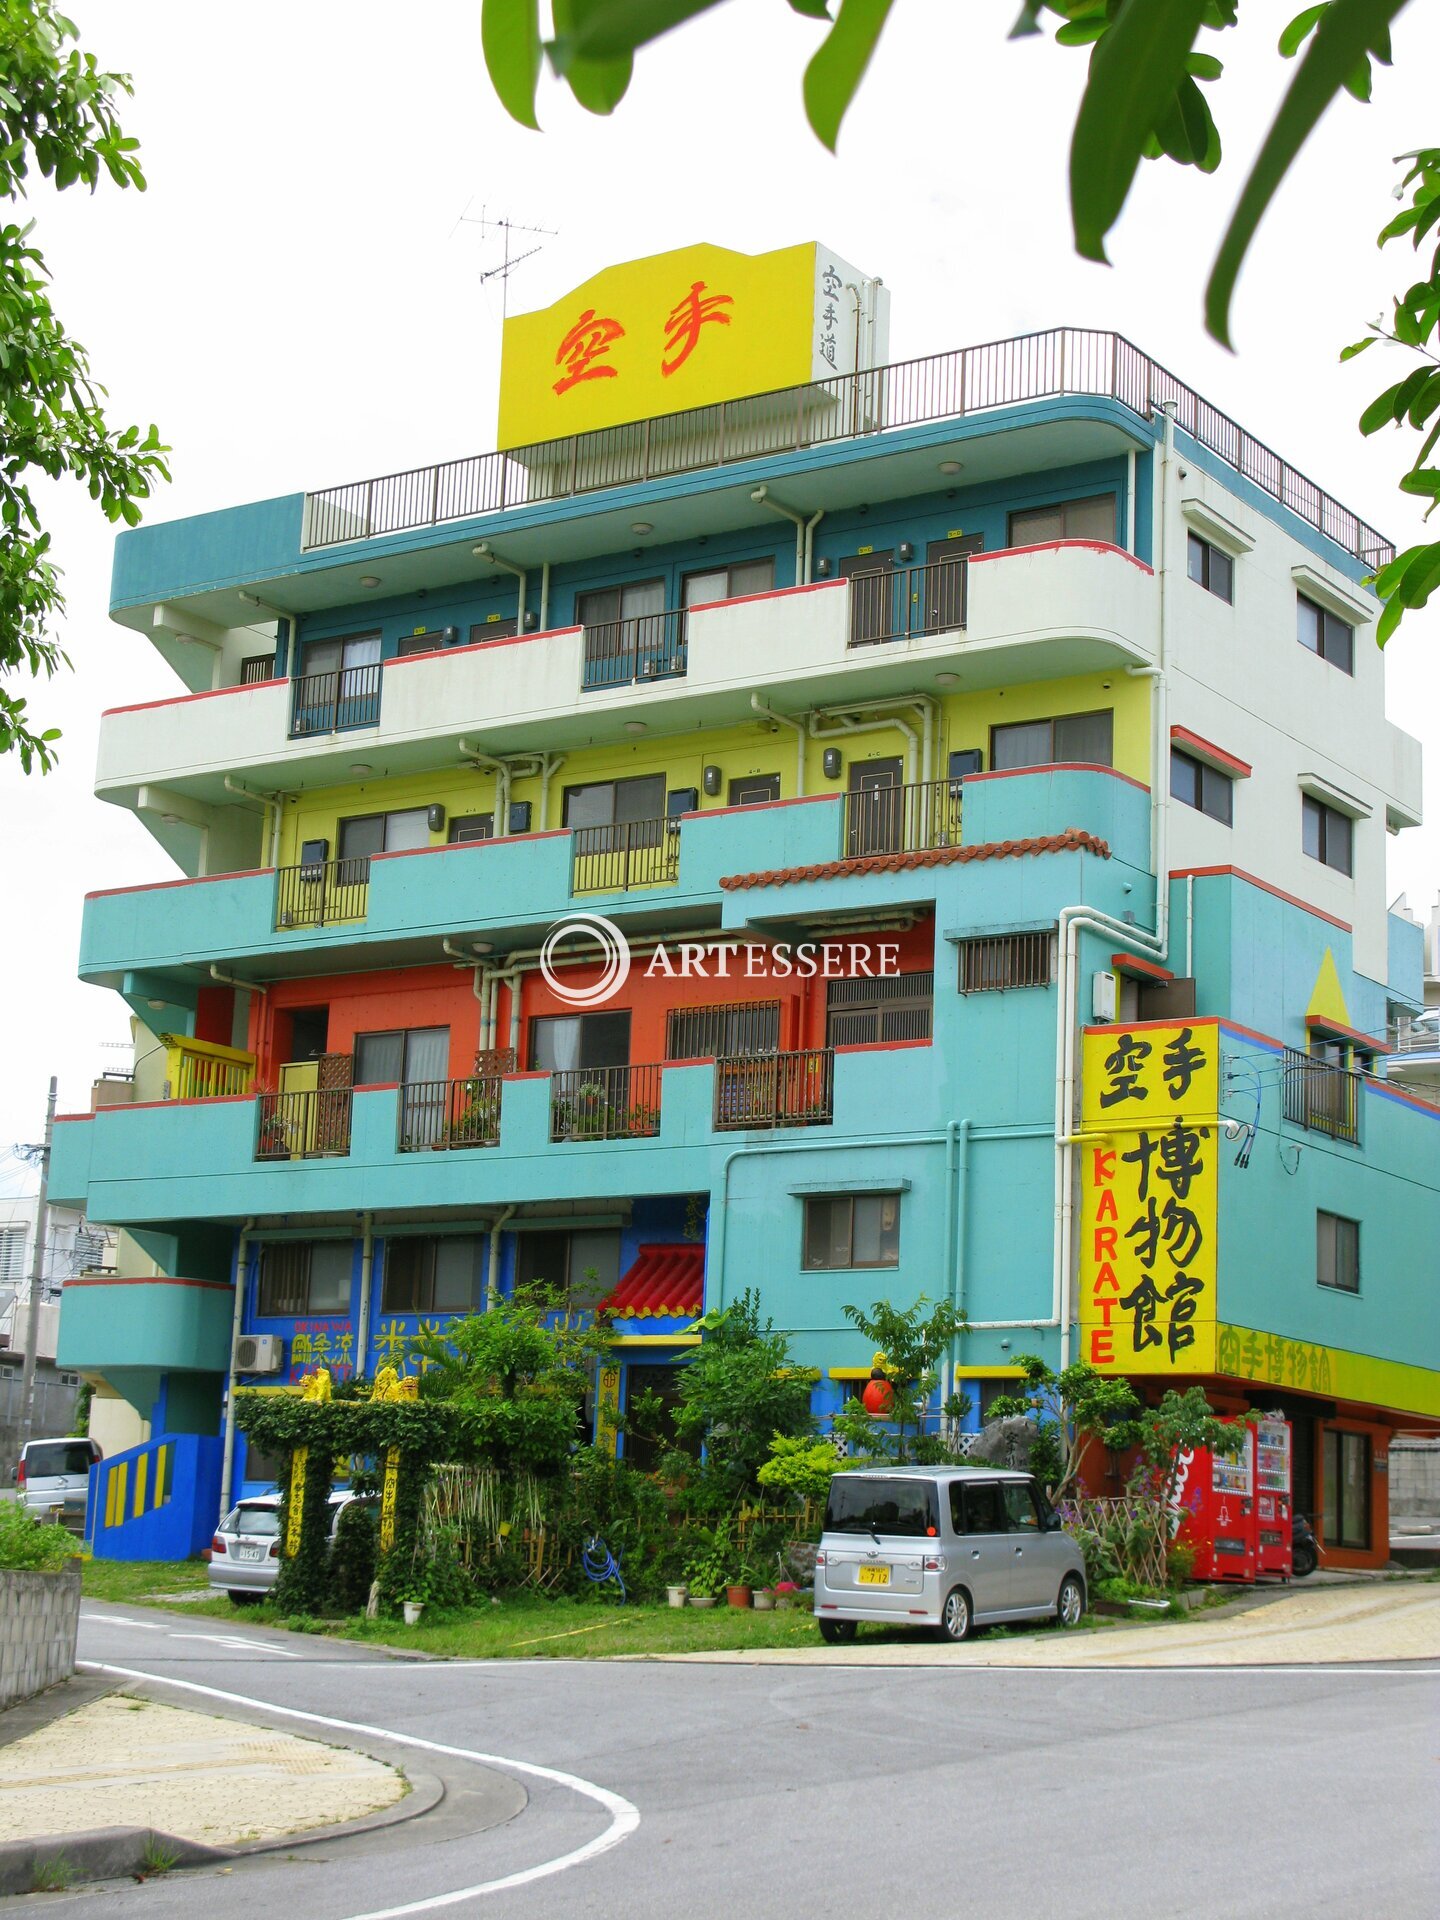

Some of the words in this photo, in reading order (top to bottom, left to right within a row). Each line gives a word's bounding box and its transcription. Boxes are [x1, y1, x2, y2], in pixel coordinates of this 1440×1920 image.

[552, 281, 734, 396] 空手
[819, 265, 843, 371] 空手道
[1100, 1028, 1206, 1108] 空手
[1091, 1148, 1119, 1364] KARATE
[1120, 1115, 1210, 1364] 博物館
[294, 1320, 352, 1332] OKINAWA
